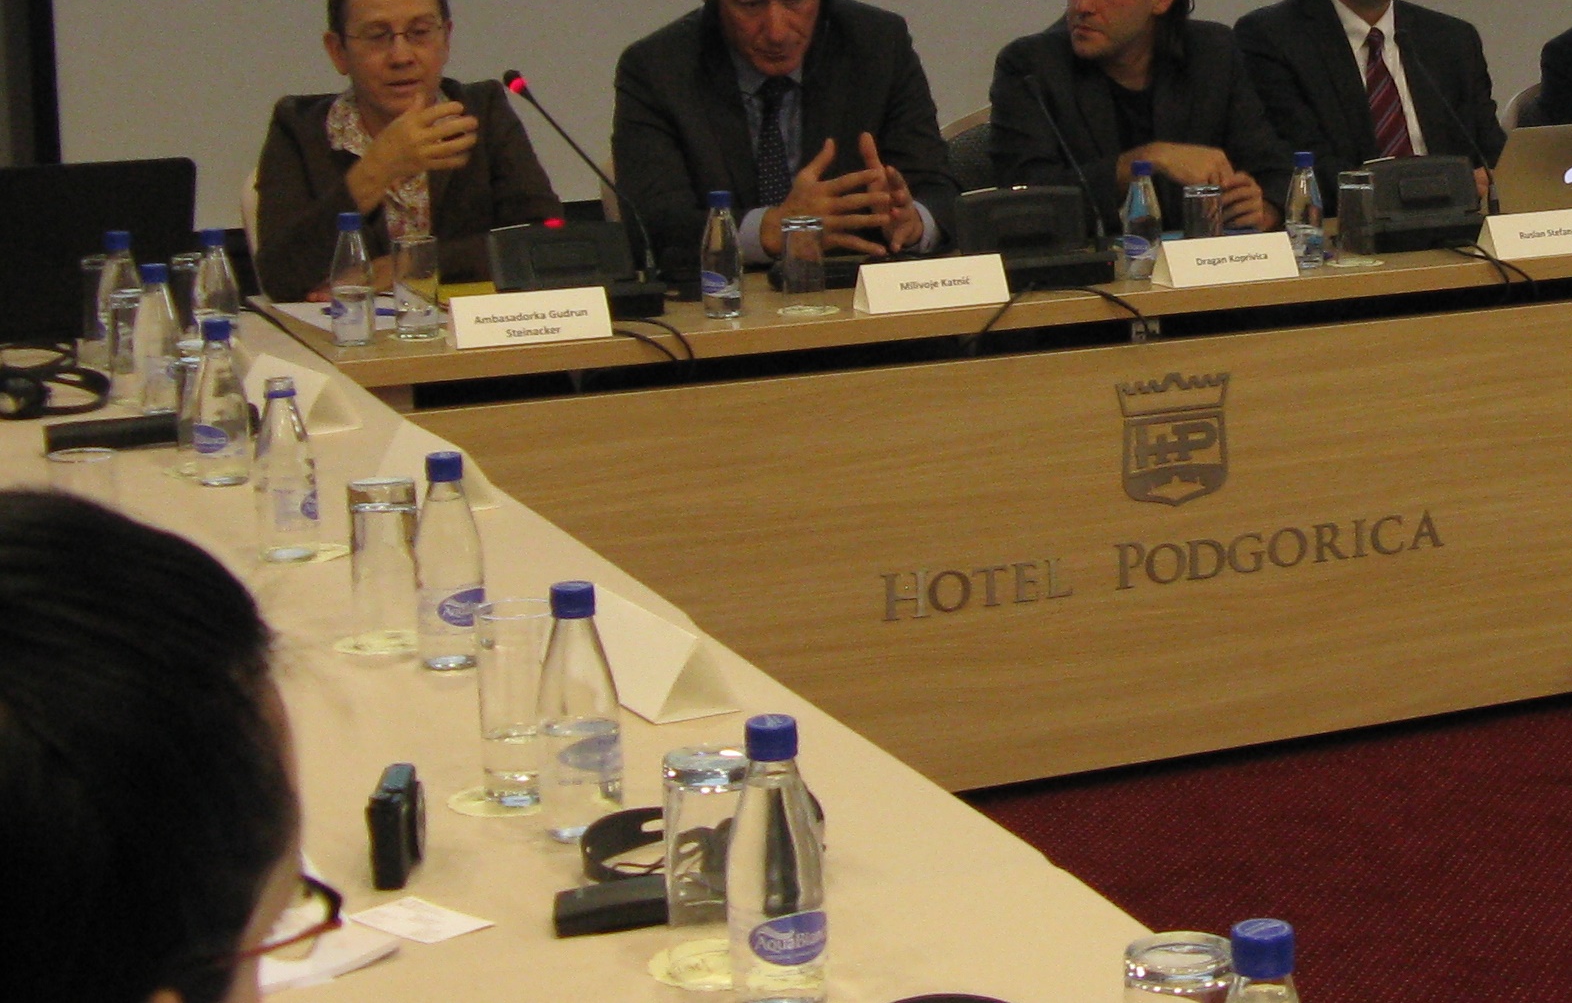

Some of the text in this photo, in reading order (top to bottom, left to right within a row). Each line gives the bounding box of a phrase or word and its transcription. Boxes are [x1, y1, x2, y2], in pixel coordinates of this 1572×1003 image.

[1196, 257, 1227, 266] Dragan
[474, 309, 588, 324] Ambasadorka Gudrun
[506, 326, 561, 338] Steinacker
[879, 509, 1445, 622] HOTEL PODGORICA
